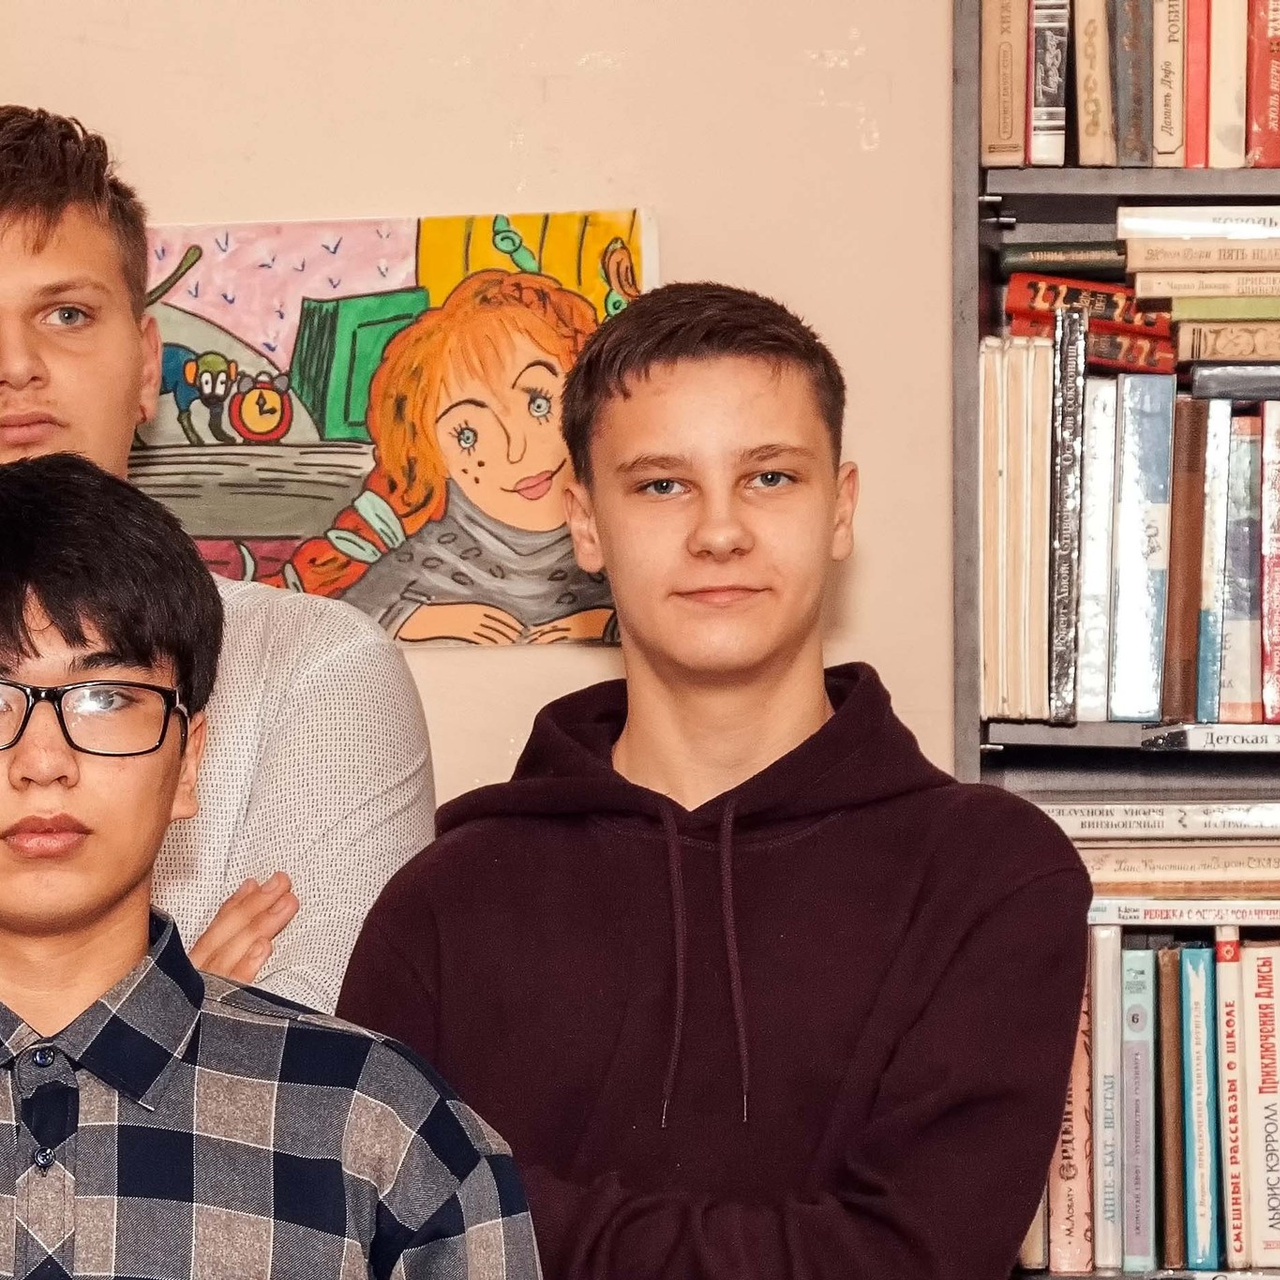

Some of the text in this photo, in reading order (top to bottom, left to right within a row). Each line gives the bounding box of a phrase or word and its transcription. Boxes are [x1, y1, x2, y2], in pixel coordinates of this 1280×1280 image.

[1203, 732, 1269, 748] Детская
[1253, 956, 1275, 999] Алисы
[1131, 1012, 1140, 1025] 6
[1224, 999, 1237, 1054] ШКОЛЕ
[1257, 1003, 1279, 1095] Приключения
[1263, 1102, 1280, 1172] КЭРРОЛЛ
[1229, 1171, 1245, 1254] СМЕШНЫЕ
